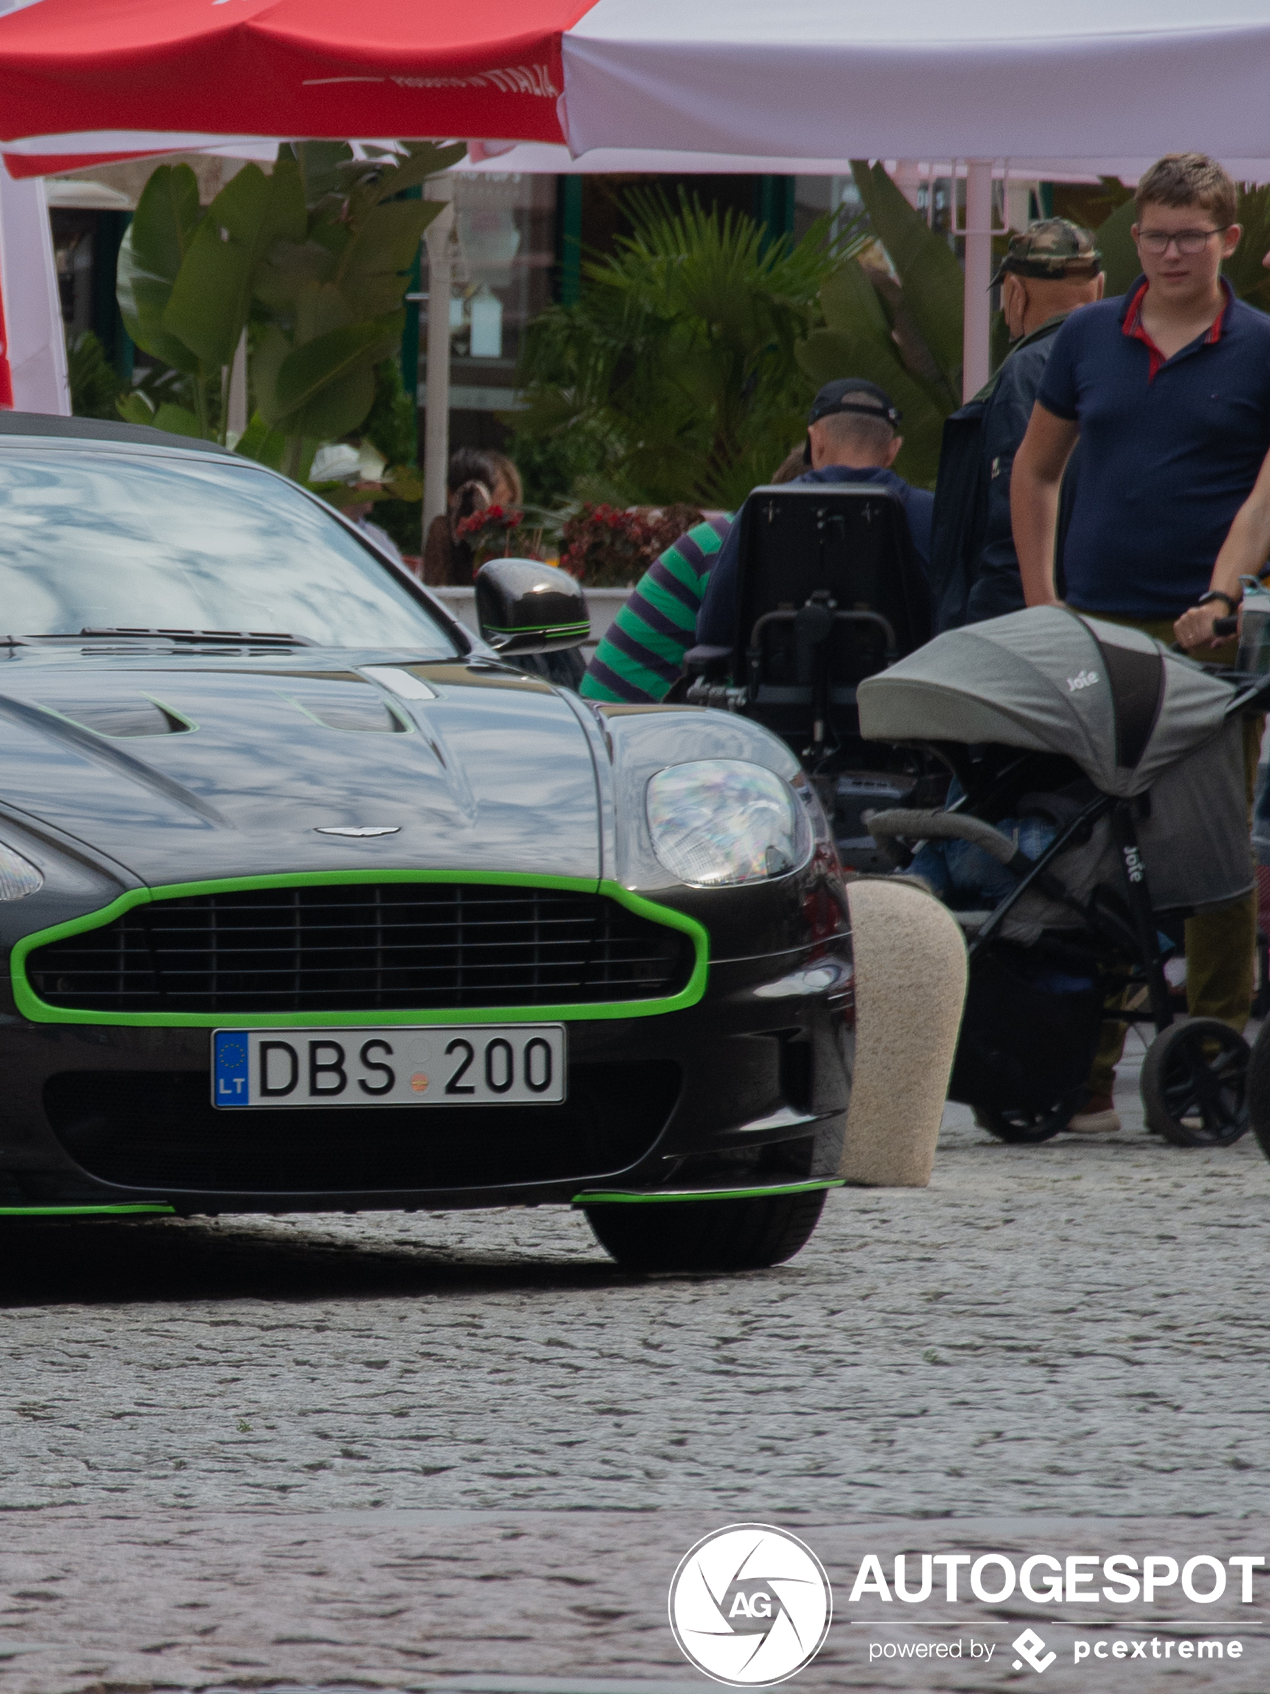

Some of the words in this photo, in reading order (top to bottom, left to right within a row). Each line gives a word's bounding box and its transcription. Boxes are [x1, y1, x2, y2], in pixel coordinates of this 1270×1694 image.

[1067, 670, 1098, 692] Joie
[1124, 846, 1144, 882] Joie
[258, 1037, 397, 1098] DBS
[443, 1035, 554, 1096] 200
[218, 1077, 247, 1095] LT
